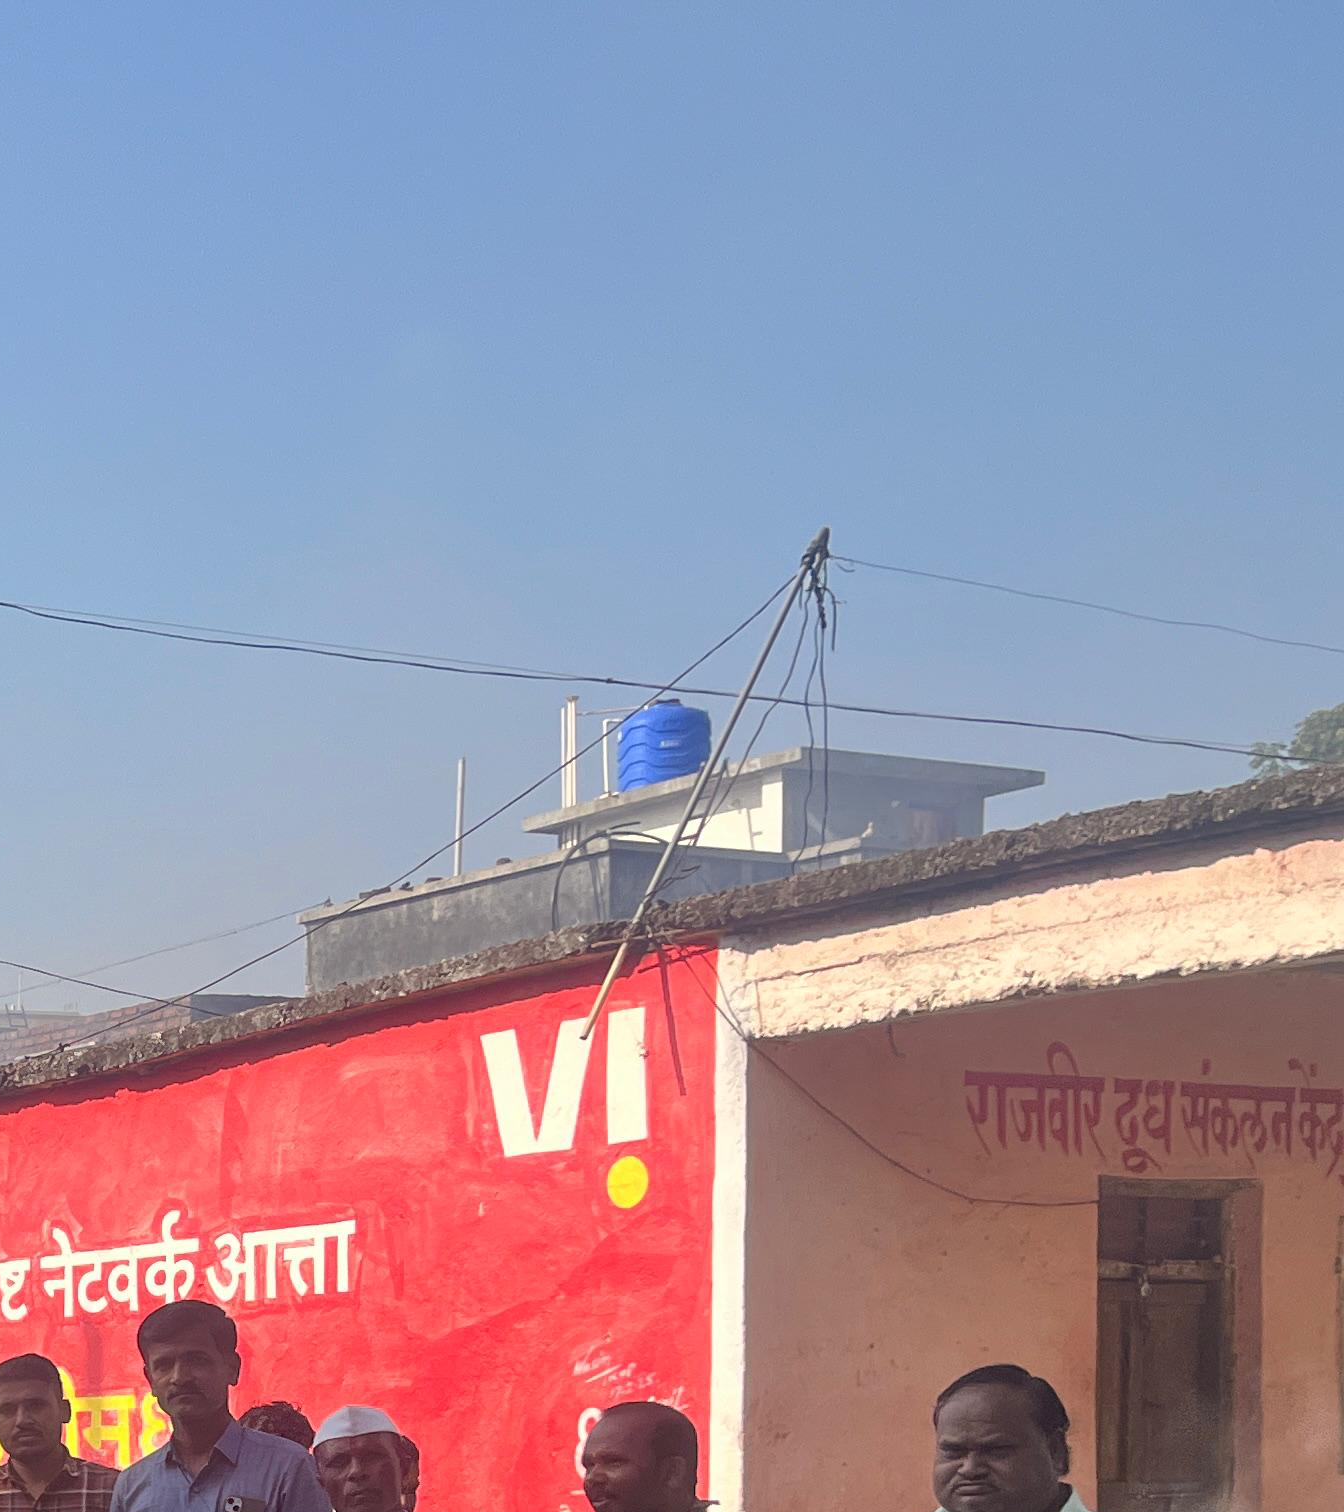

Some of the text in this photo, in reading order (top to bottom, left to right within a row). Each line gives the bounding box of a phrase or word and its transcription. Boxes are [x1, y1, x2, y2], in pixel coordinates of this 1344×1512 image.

[964, 1041, 1106, 1160] राजवीर
[1113, 1078, 1176, 1173] दूध
[1180, 1058, 1297, 1170] संकलन
[40, 1211, 199, 1318] नेटवर्क
[206, 1220, 356, 1303] आत्ता
